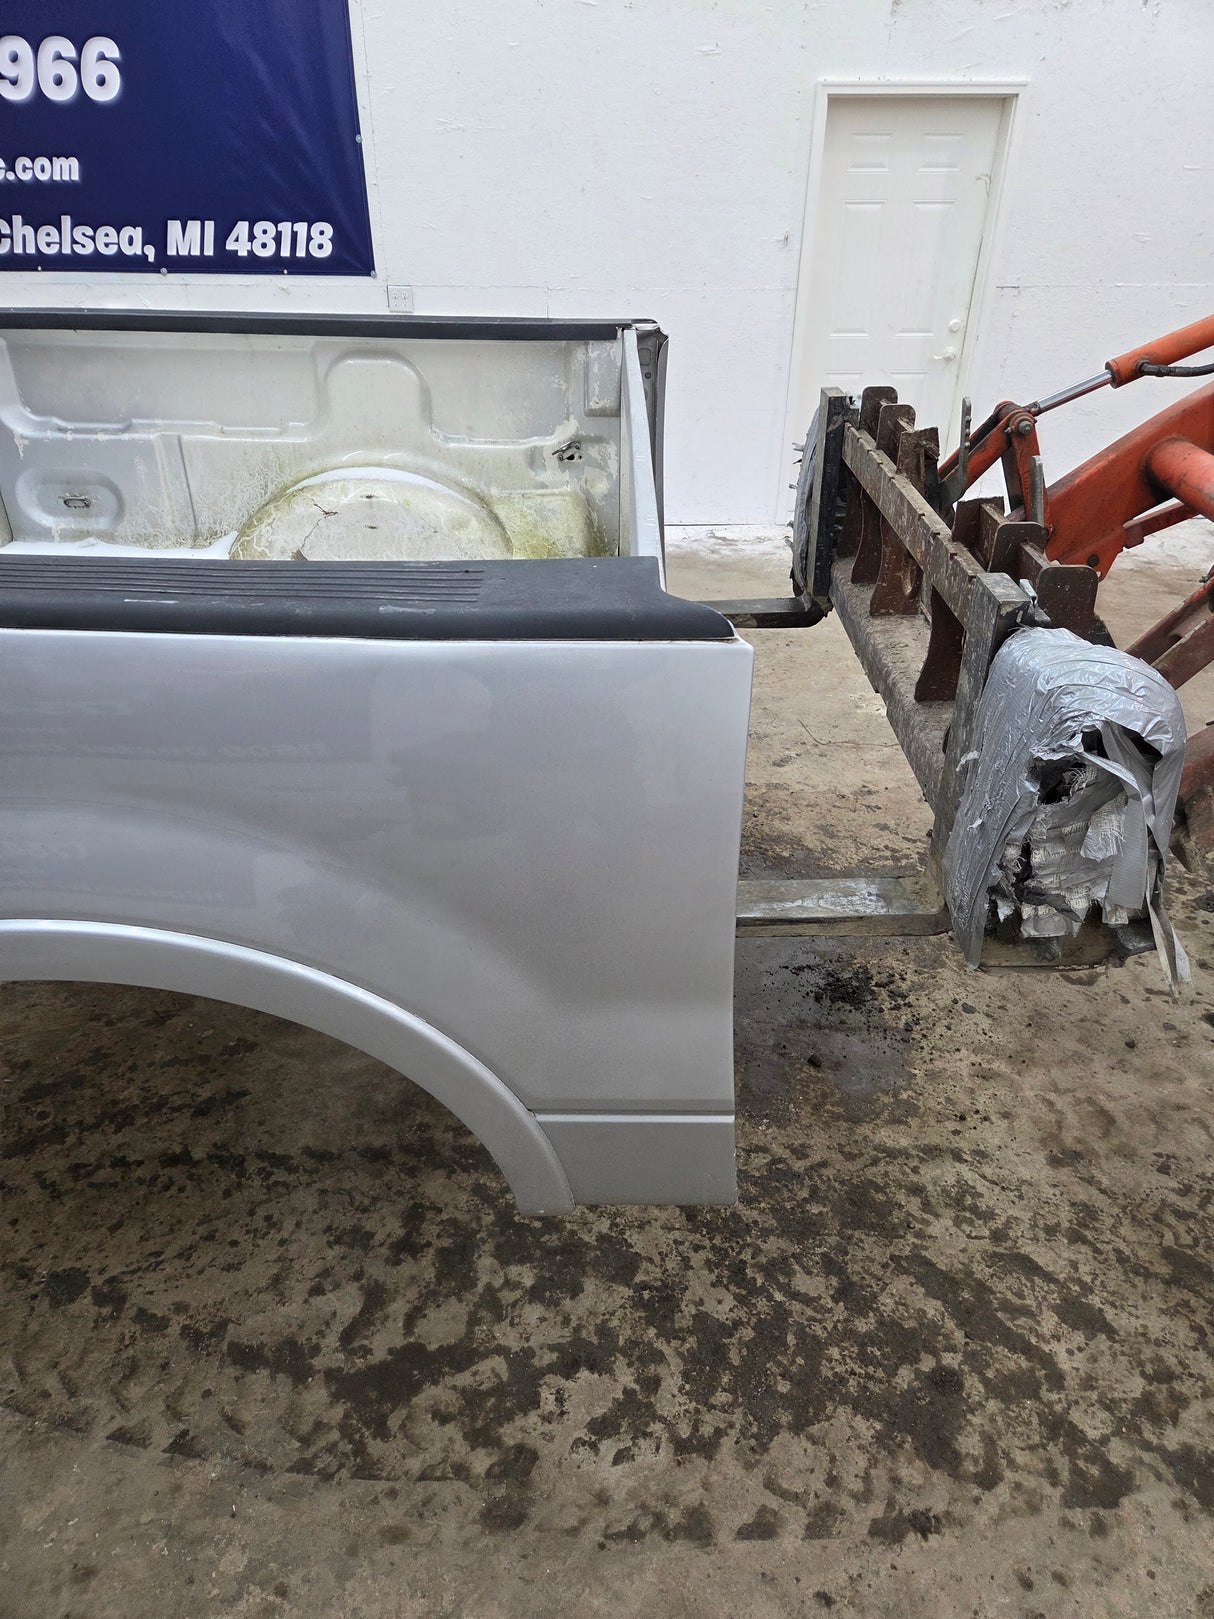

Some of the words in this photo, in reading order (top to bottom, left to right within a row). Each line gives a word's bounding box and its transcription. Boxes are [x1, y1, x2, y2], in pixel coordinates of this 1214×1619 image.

[0, 35, 121, 101] 966
[166, 219, 215, 257] MI
[225, 220, 334, 258] 48118
